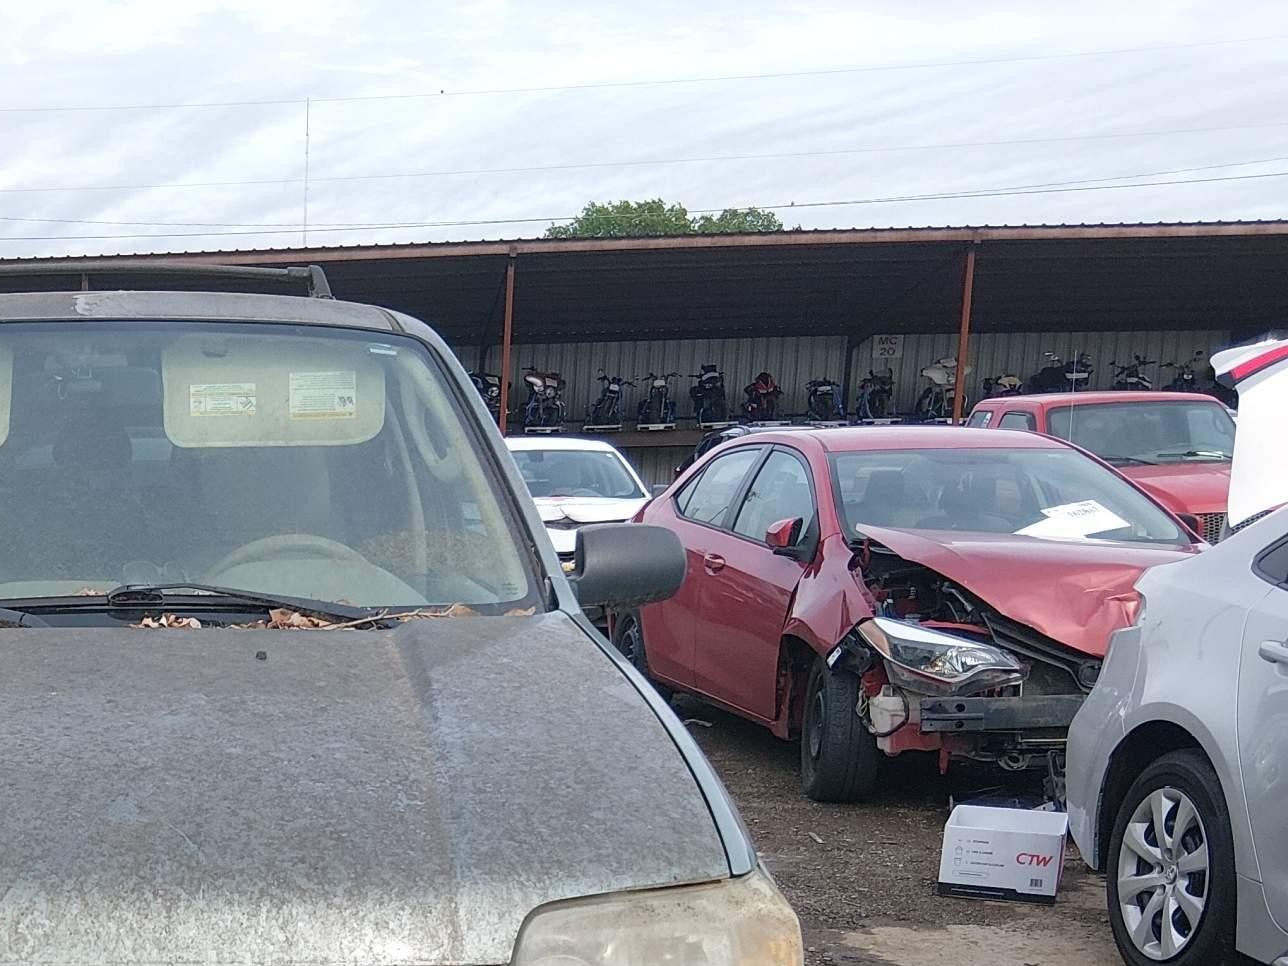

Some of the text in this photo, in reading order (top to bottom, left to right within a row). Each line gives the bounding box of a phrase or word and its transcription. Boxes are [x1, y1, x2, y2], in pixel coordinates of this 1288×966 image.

[878, 336, 898, 346] MC
[879, 347, 896, 356] 20
[1015, 852, 1054, 867] CTW
